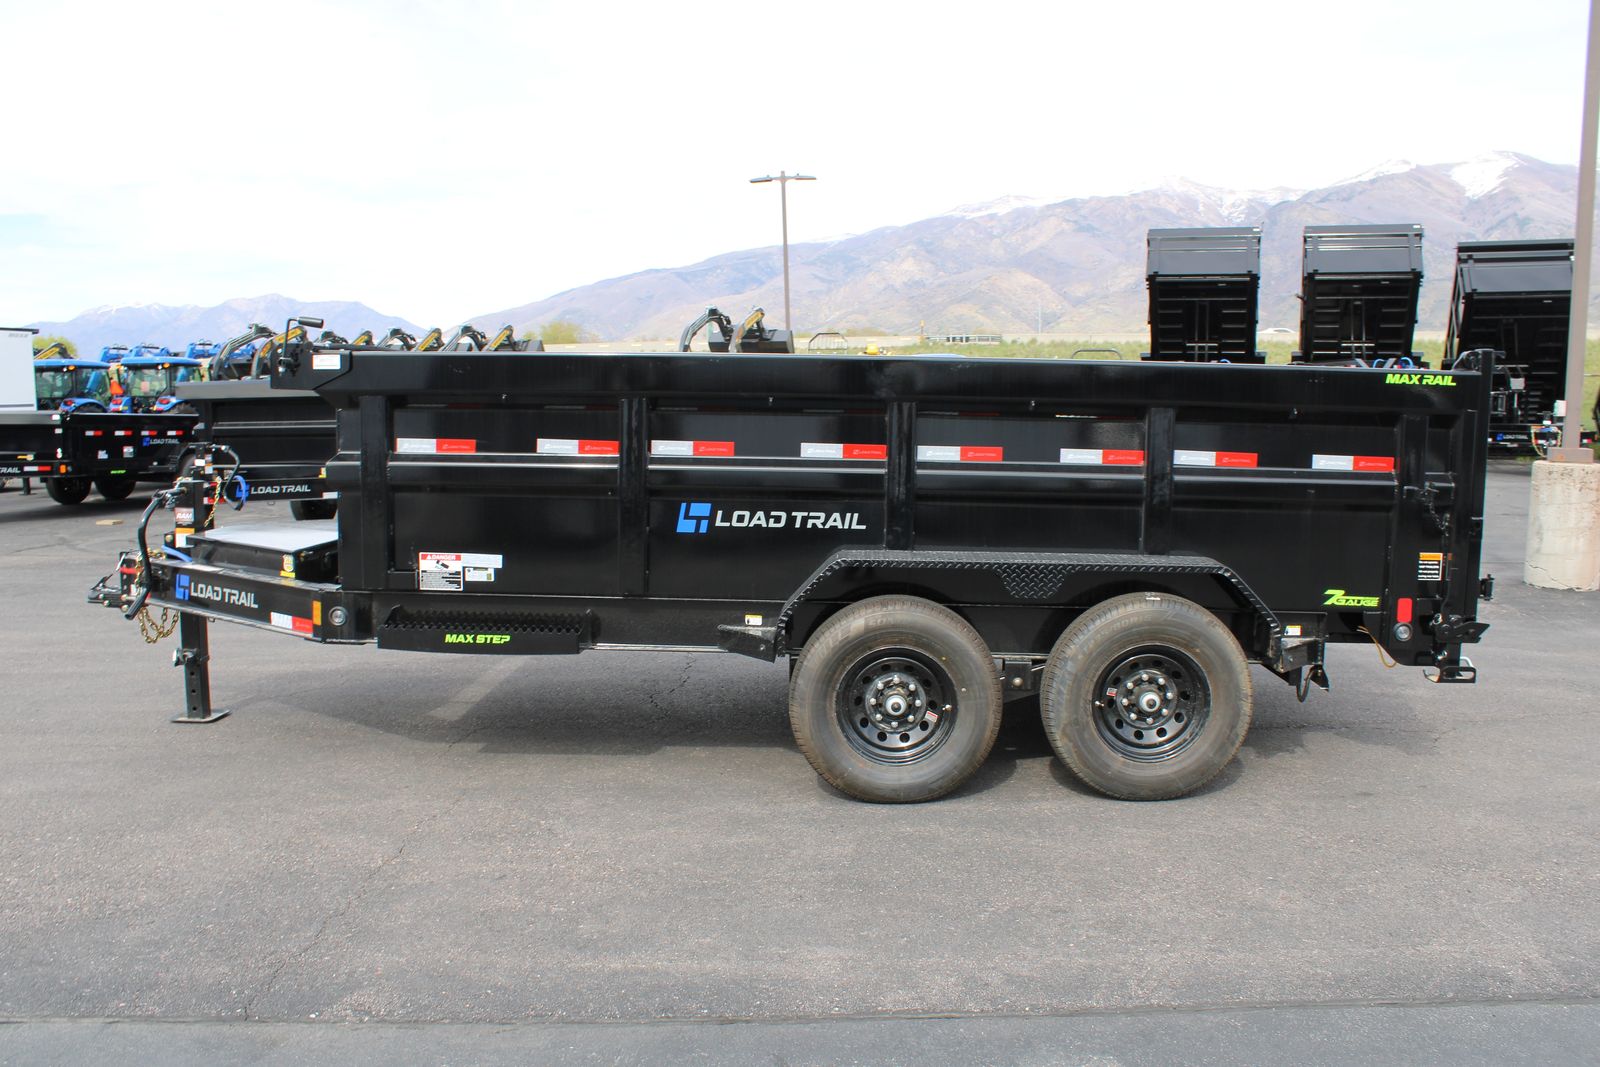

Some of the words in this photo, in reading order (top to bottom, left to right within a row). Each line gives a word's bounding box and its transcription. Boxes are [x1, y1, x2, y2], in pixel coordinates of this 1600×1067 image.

[1385, 373, 1421, 385] MAX
[1422, 375, 1457, 386] RAIL
[250, 486, 281, 495] LOAD
[281, 484, 312, 493] TRAIL
[715, 510, 788, 528] LOAD
[791, 511, 867, 530] TRAIL
[190, 582, 222, 601] LOAD
[223, 588, 259, 609] TRAIL
[1323, 589, 1346, 605] 7
[1335, 598, 1379, 607] GAUGE
[445, 633, 475, 643] MAX
[476, 634, 511, 644] STEP
